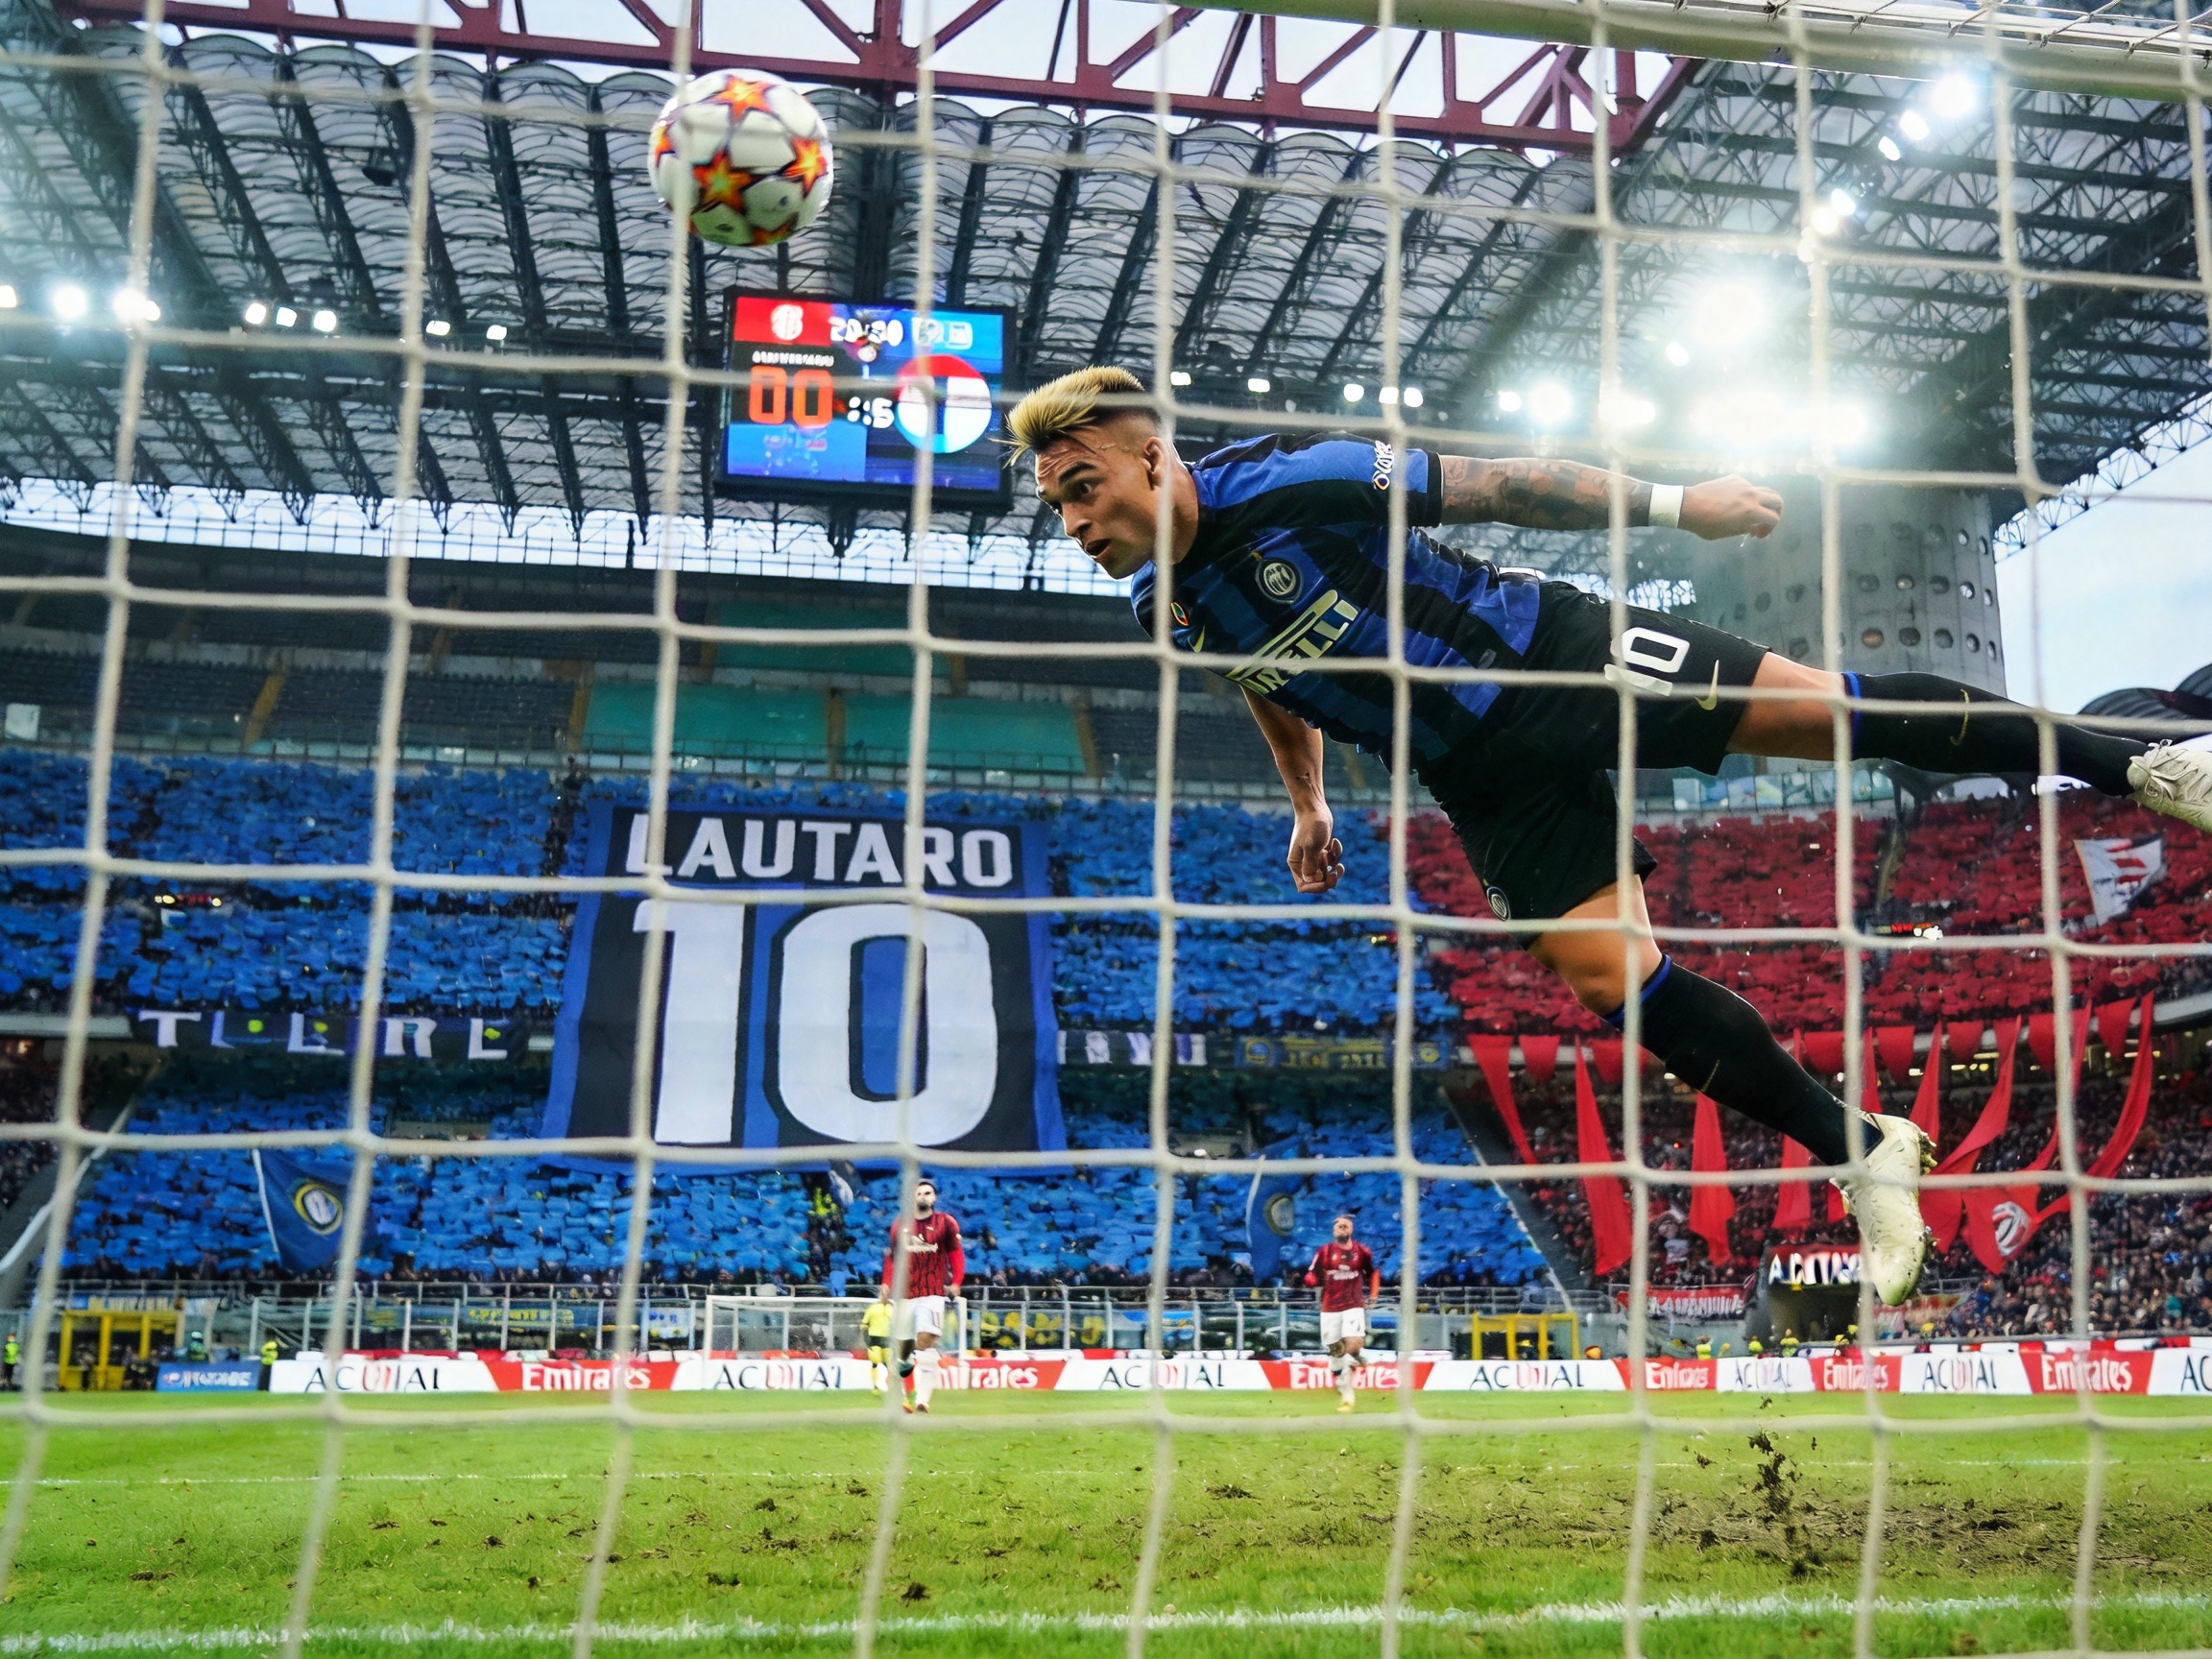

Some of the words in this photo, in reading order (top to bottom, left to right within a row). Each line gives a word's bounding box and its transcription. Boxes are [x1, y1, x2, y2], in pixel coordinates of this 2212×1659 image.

[1604, 627, 1690, 696] 10
[626, 813, 1013, 887] LAUTARO
[633, 899, 998, 1146] 10
